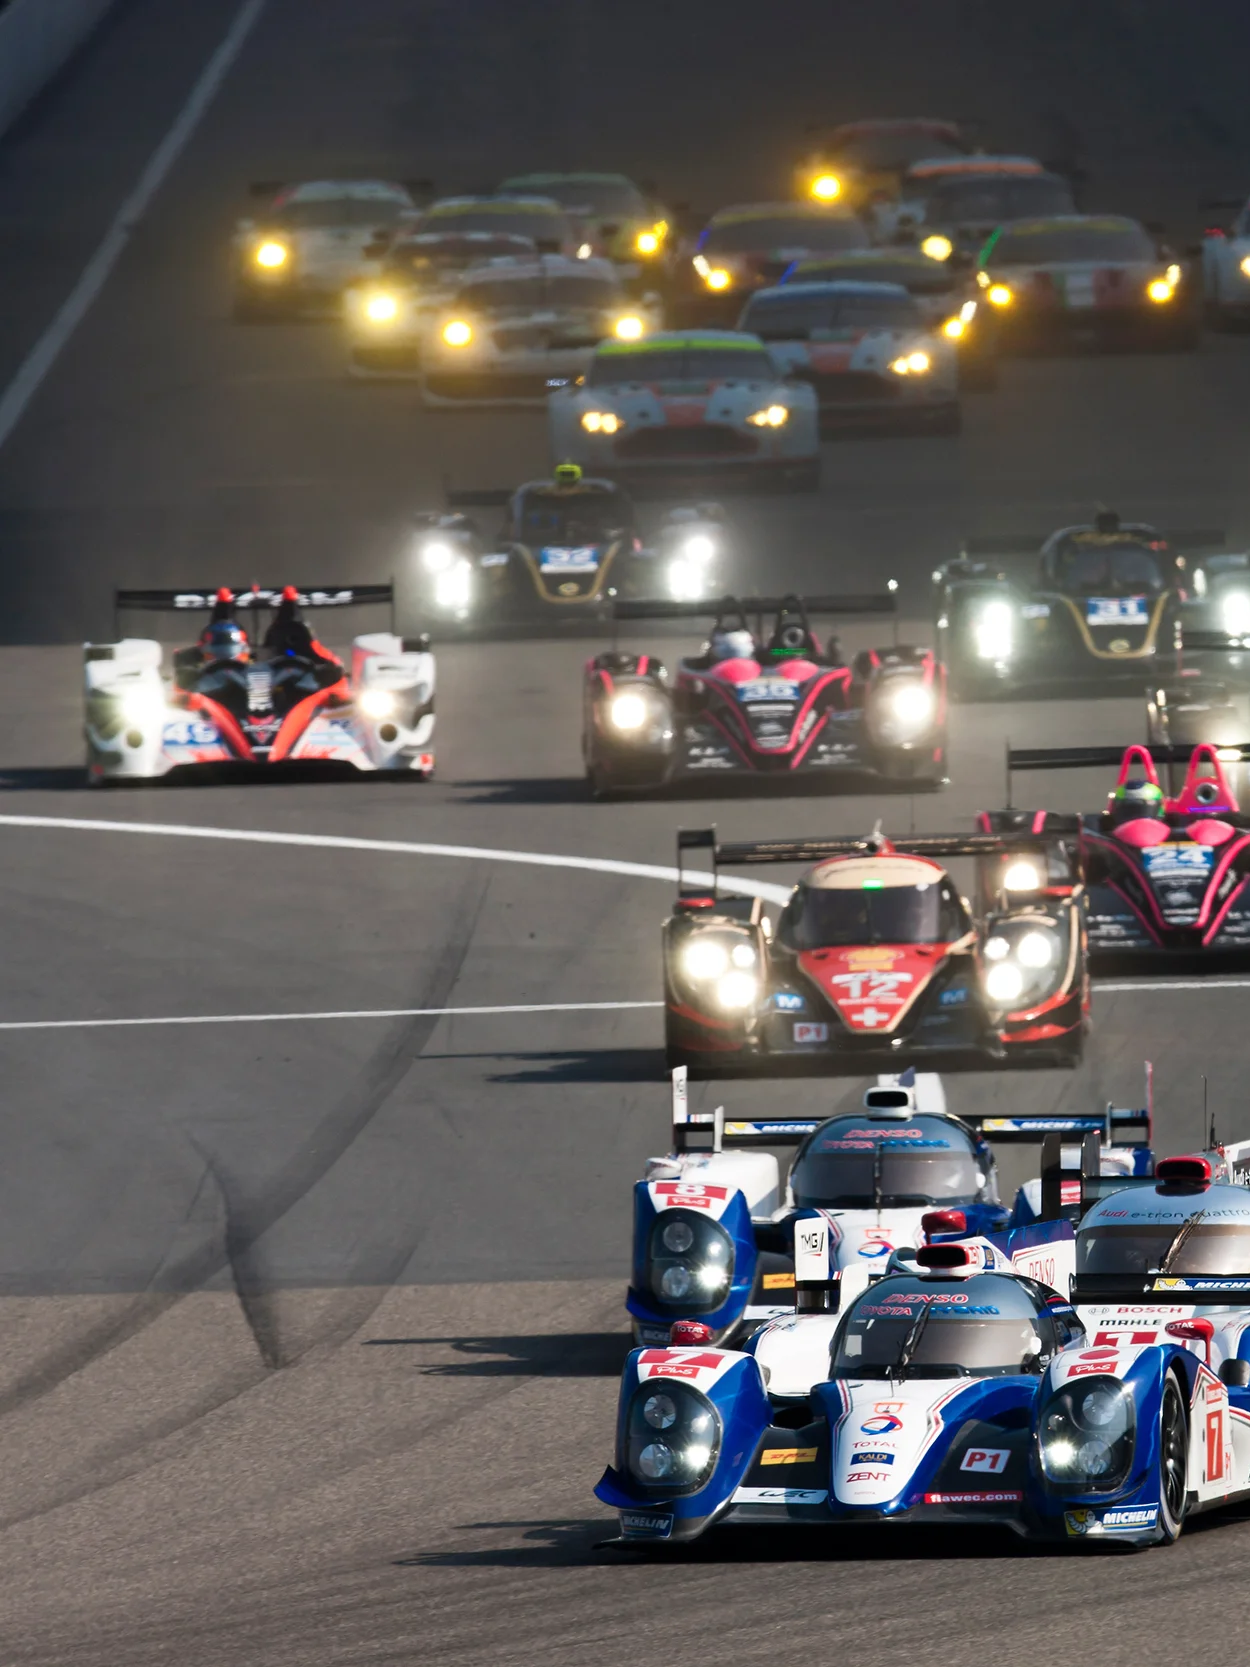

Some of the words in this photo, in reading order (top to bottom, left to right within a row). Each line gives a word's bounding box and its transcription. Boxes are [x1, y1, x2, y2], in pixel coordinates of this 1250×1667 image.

[798, 1026, 822, 1040] P1
[843, 1129, 922, 1139] DENSO
[675, 1185, 706, 1195] 8
[1098, 1209, 1128, 1218] Audi
[1028, 1257, 1055, 1286] DENSO
[882, 1293, 969, 1304] DENSO
[860, 1305, 913, 1316] TOYOTA
[1117, 1306, 1183, 1314] BOSCH
[677, 1325, 705, 1334] TOTAL
[664, 1351, 703, 1364] 7
[656, 1366, 694, 1375] Plus
[1074, 1363, 1112, 1373] Plus
[852, 1440, 898, 1449] TOTAL
[1210, 1416, 1219, 1476] 7
[858, 1453, 887, 1461] KALDI
[965, 1451, 1002, 1469] P1
[846, 1472, 892, 1484] ZENT
[758, 1490, 818, 1499] WEC
[1103, 1509, 1158, 1525] MICHELIN
